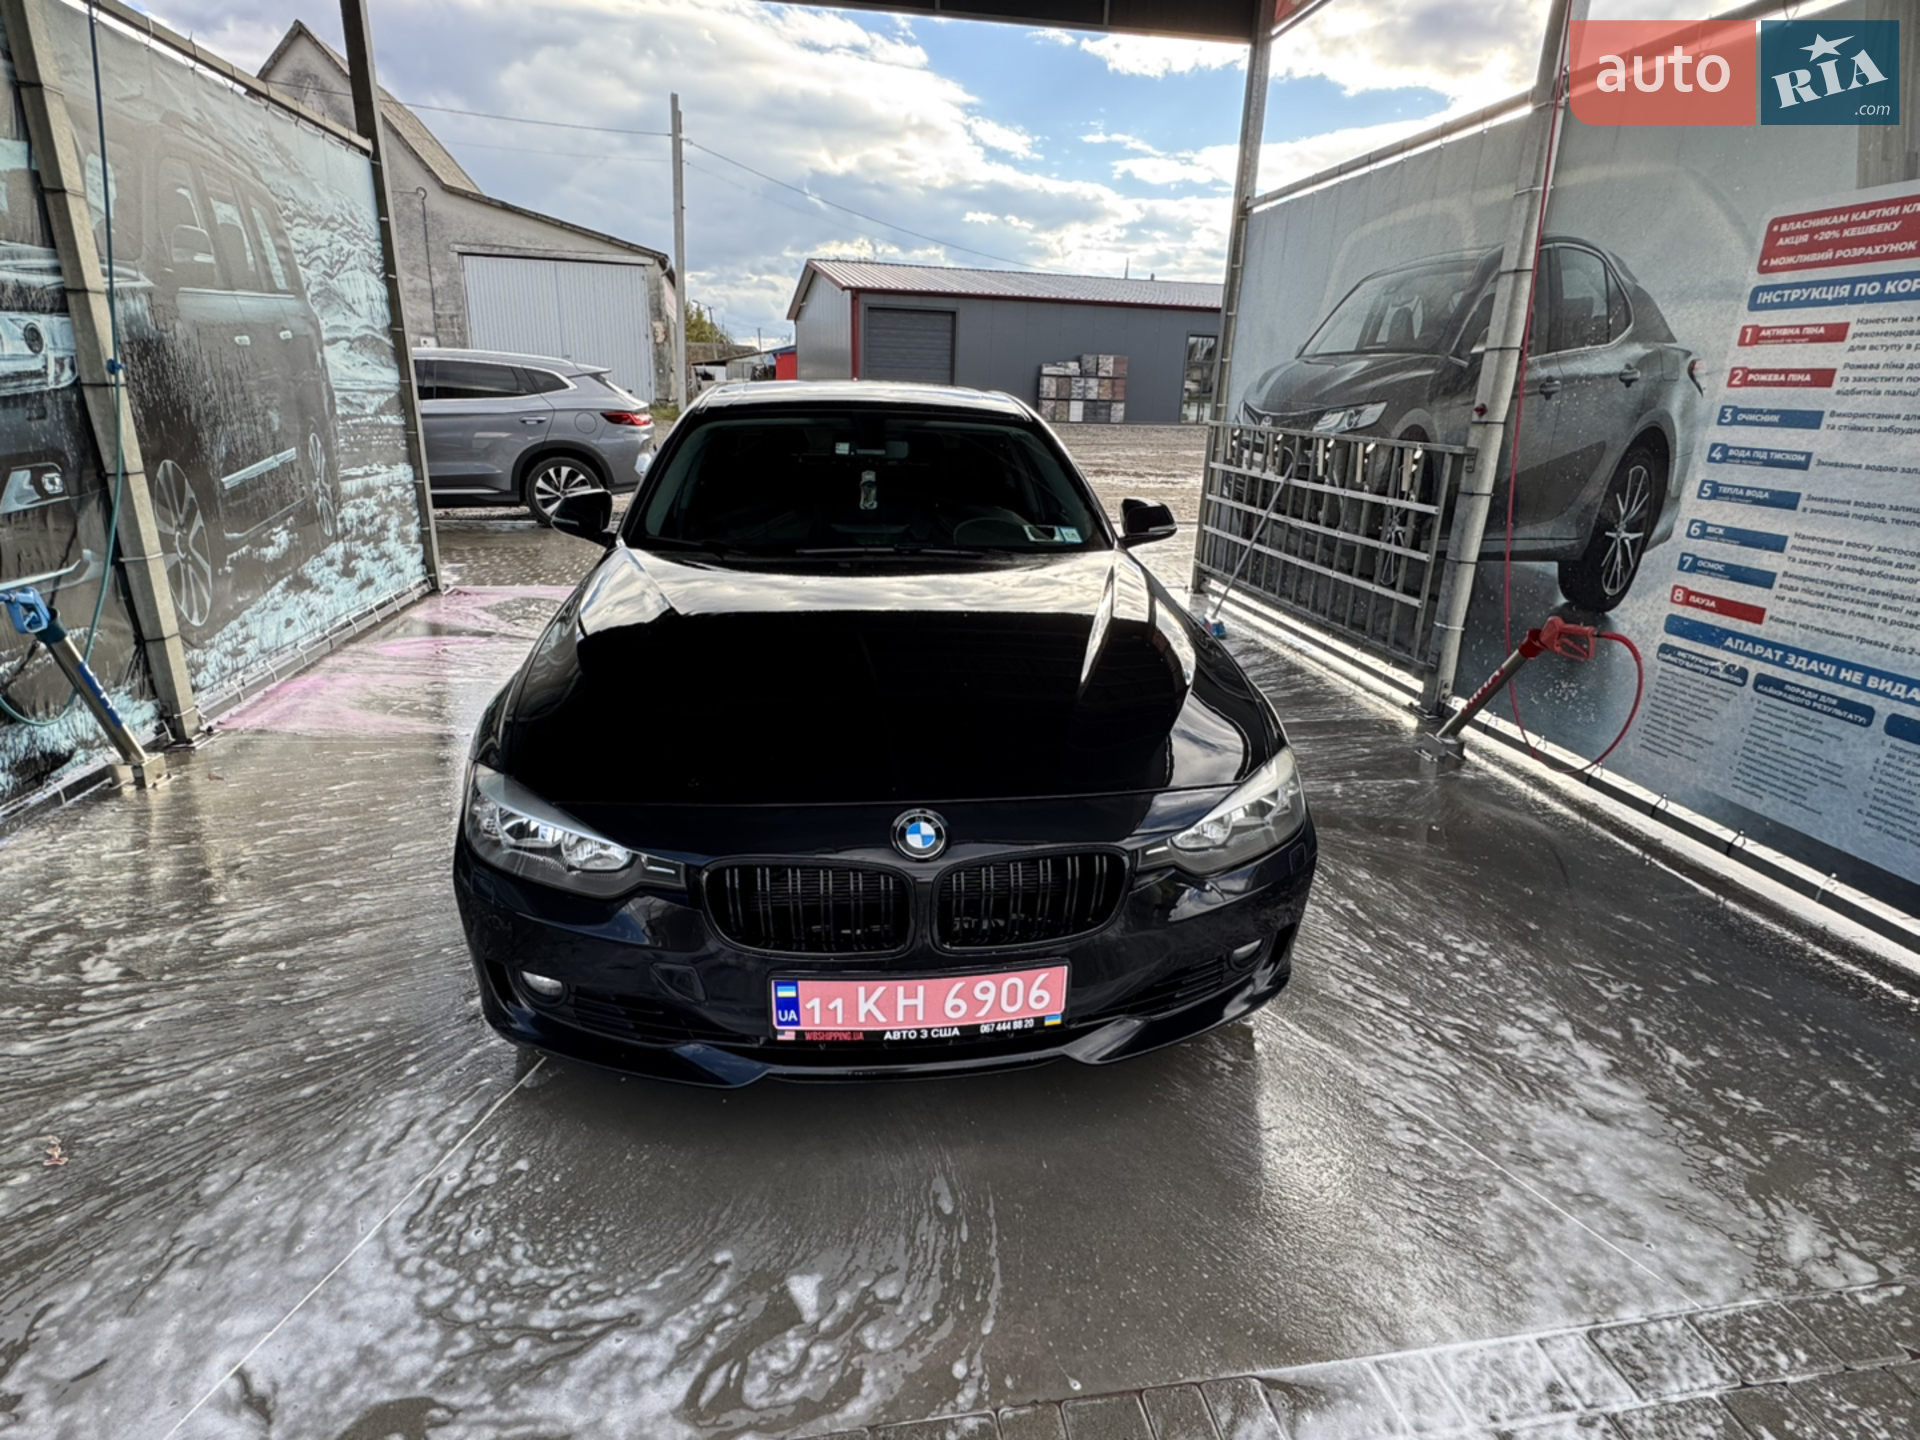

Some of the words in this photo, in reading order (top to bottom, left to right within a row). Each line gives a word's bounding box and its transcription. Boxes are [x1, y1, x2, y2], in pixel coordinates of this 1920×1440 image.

[1780, 213, 1850, 233] ВЛАСНИКАМ
[1850, 204, 1900, 222] КАРТКИ
[1813, 230, 1840, 242] +20%
[1842, 220, 1902, 238] КЕШБЕКУ
[1769, 249, 1833, 267] МОЖЛИВИЙ
[1834, 240, 1918, 260] РОЗРАХУНОК
[1757, 285, 1851, 305] ІНСТРУКЦІЯ
[1854, 282, 1881, 297] ПО
[1744, 328, 1753, 344] 1
[1760, 327, 1800, 338] АКТИВНА
[1731, 370, 1743, 385] 2
[1721, 408, 1733, 423] 3
[1711, 446, 1723, 461] 4
[1728, 448, 1751, 458] ВОДА
[1701, 482, 1713, 497] 5
[1690, 522, 1702, 537] 6
[1682, 555, 1694, 570] 7
[1673, 588, 1684, 602] 8
[1724, 635, 1784, 663] АПАРАТ
[1785, 652, 1837, 677] ЗДАЧІ
[1838, 667, 1865, 686] НЕ
[1866, 675, 1920, 702] ВИДА
[805, 997, 844, 1025] 11
[857, 984, 925, 1024] KH
[944, 972, 1051, 1020] 6906
[778, 1009, 798, 1022] UA
[980, 1023, 995, 1034] 067
[996, 1021, 1012, 1032] 444
[1024, 1018, 1034, 1029] 20
[883, 1029, 917, 1041] АВТО
[930, 1027, 960, 1039] США
